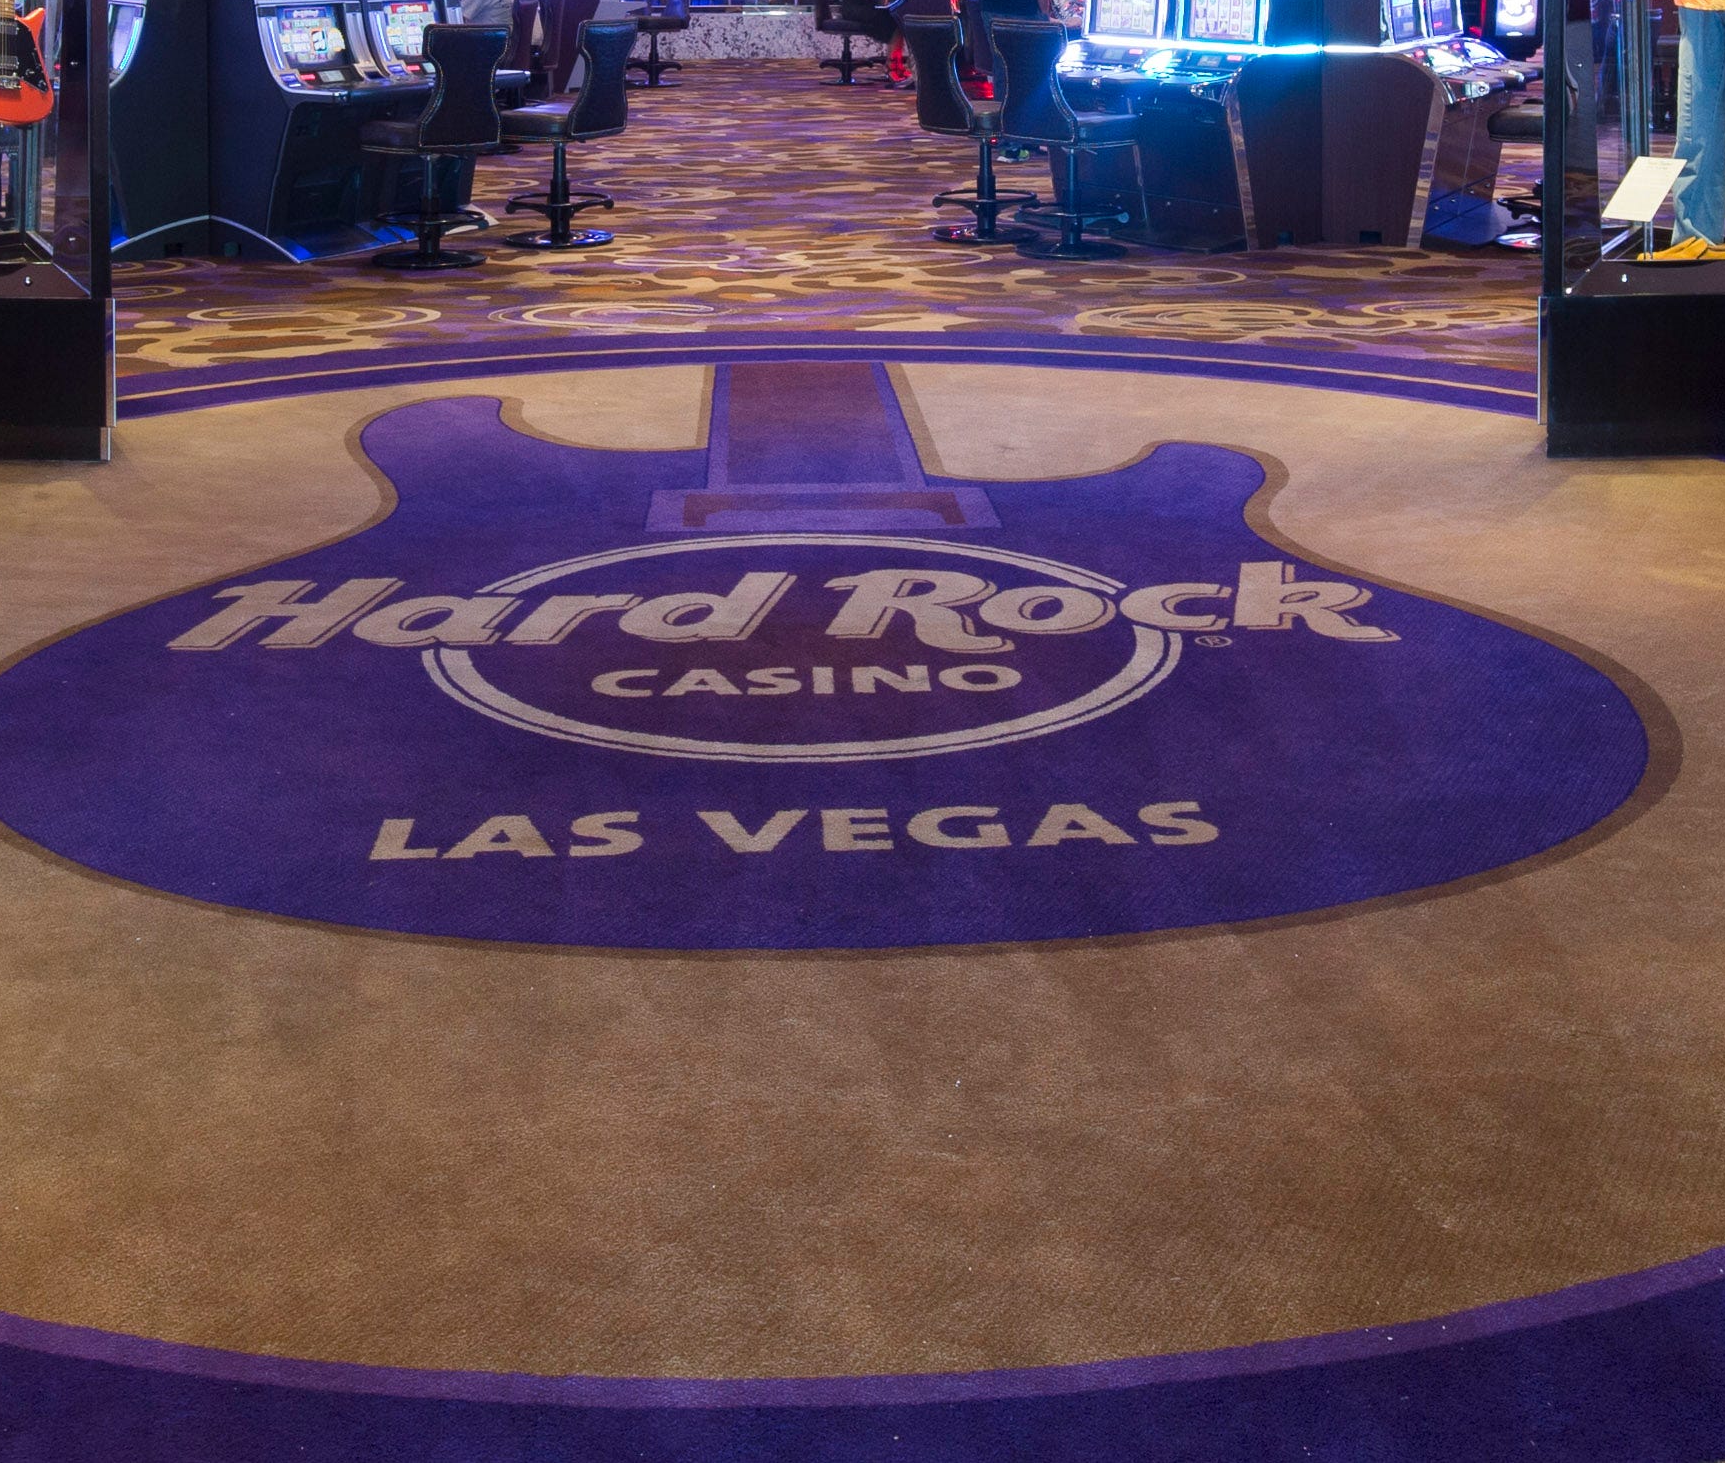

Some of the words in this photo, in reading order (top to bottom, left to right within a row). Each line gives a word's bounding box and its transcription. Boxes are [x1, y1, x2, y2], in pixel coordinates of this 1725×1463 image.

[167, 571, 797, 650] Hard
[824, 559, 1402, 657] Rock
[590, 663, 1024, 698] CASINO
[367, 810, 644, 862] LAS
[695, 800, 1222, 856] VEGAS
